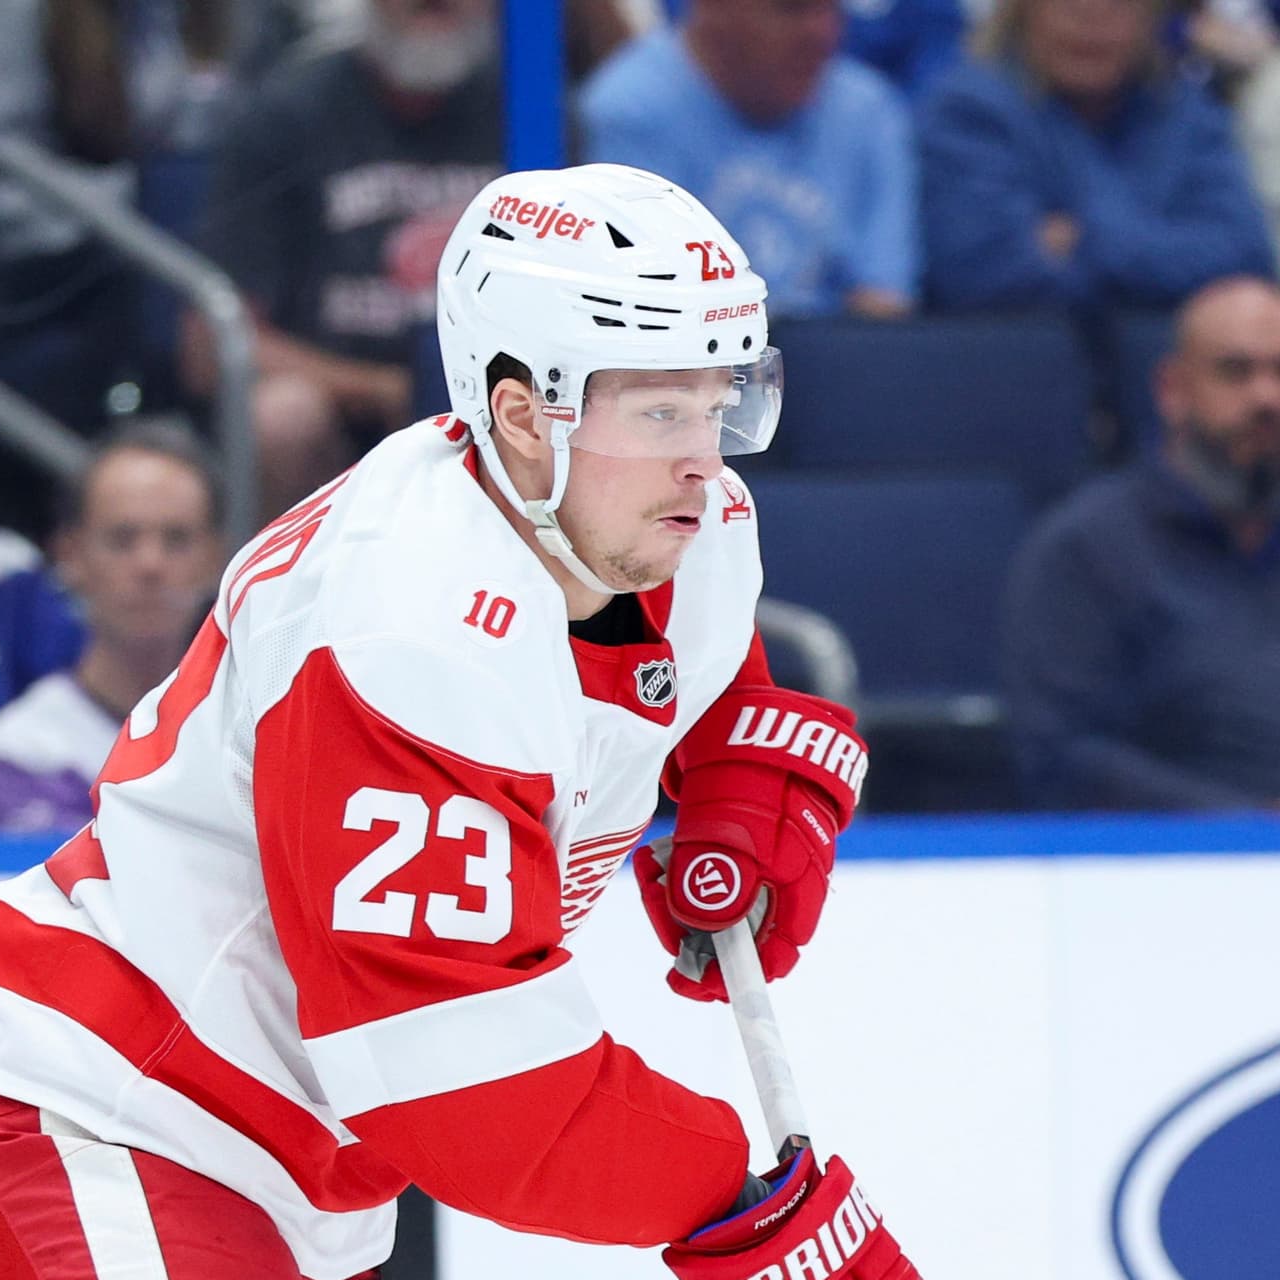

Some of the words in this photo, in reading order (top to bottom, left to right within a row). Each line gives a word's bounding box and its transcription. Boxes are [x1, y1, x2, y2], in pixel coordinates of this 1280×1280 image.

[489, 195, 595, 241] meijer
[685, 240, 735, 281] 23
[704, 303, 760, 323] BAUER
[463, 589, 517, 640] 10
[644, 666, 670, 701] NHL
[727, 705, 869, 807] WARR
[801, 808, 831, 846] COVERT
[332, 786, 514, 945] 23
